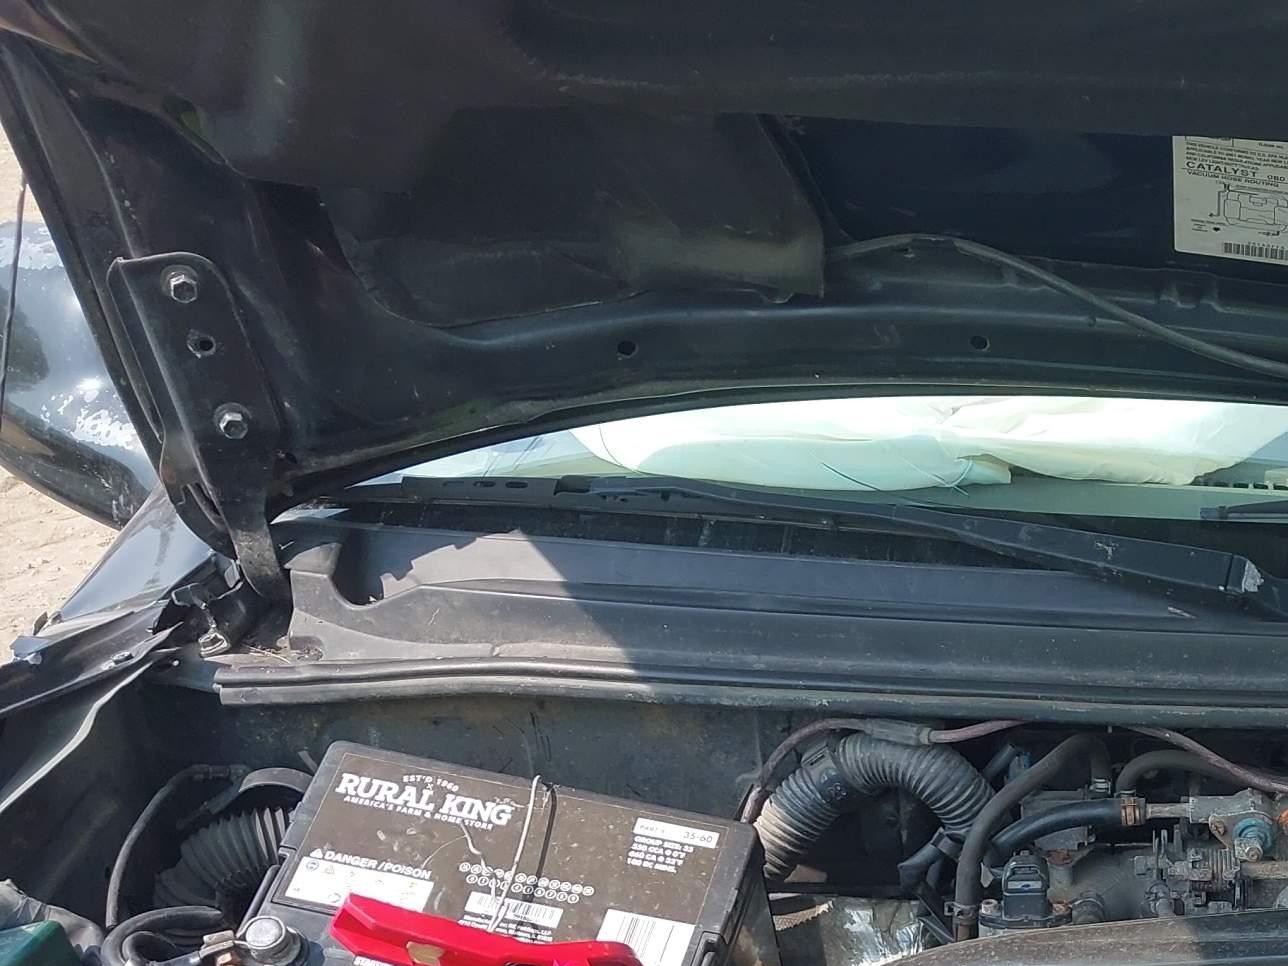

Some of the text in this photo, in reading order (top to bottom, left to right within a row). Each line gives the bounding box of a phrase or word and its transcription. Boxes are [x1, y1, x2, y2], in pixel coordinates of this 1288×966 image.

[1186, 161, 1257, 178] CATALYST
[335, 773, 516, 827] RURAL KING
[343, 795, 394, 811] AMERICA'S
[395, 805, 422, 817] FARM
[434, 813, 462, 824] HOME
[464, 819, 494, 831] STORE
[683, 831, 713, 844] 35-60
[324, 851, 379, 868] DANGER
